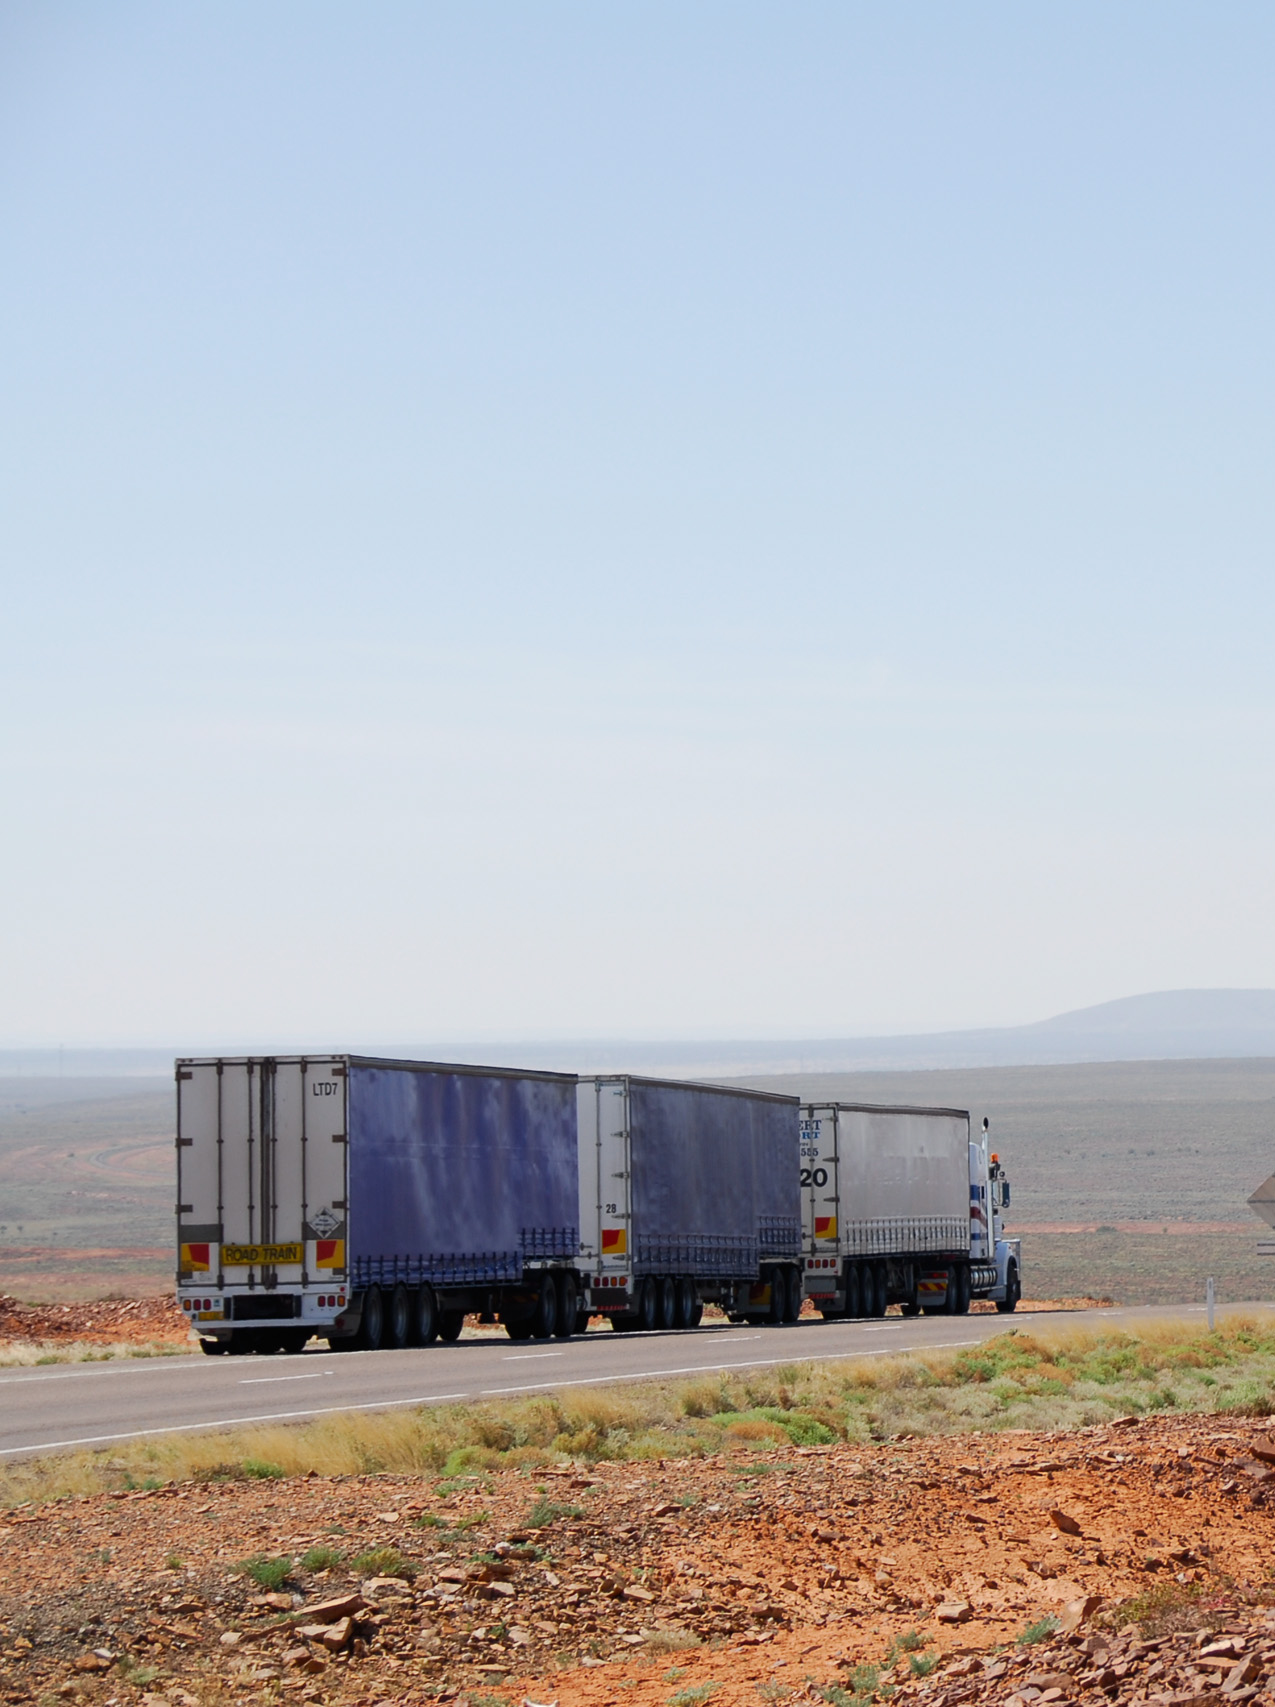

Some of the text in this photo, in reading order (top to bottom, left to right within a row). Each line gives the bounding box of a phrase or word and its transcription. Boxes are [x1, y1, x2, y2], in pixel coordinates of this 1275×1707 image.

[312, 1082, 338, 1096] LTD7
[799, 1132, 820, 1140] RT
[800, 1168, 828, 1188] 20
[606, 1203, 617, 1214] 28
[225, 1246, 298, 1262] ROAD TRAIN
